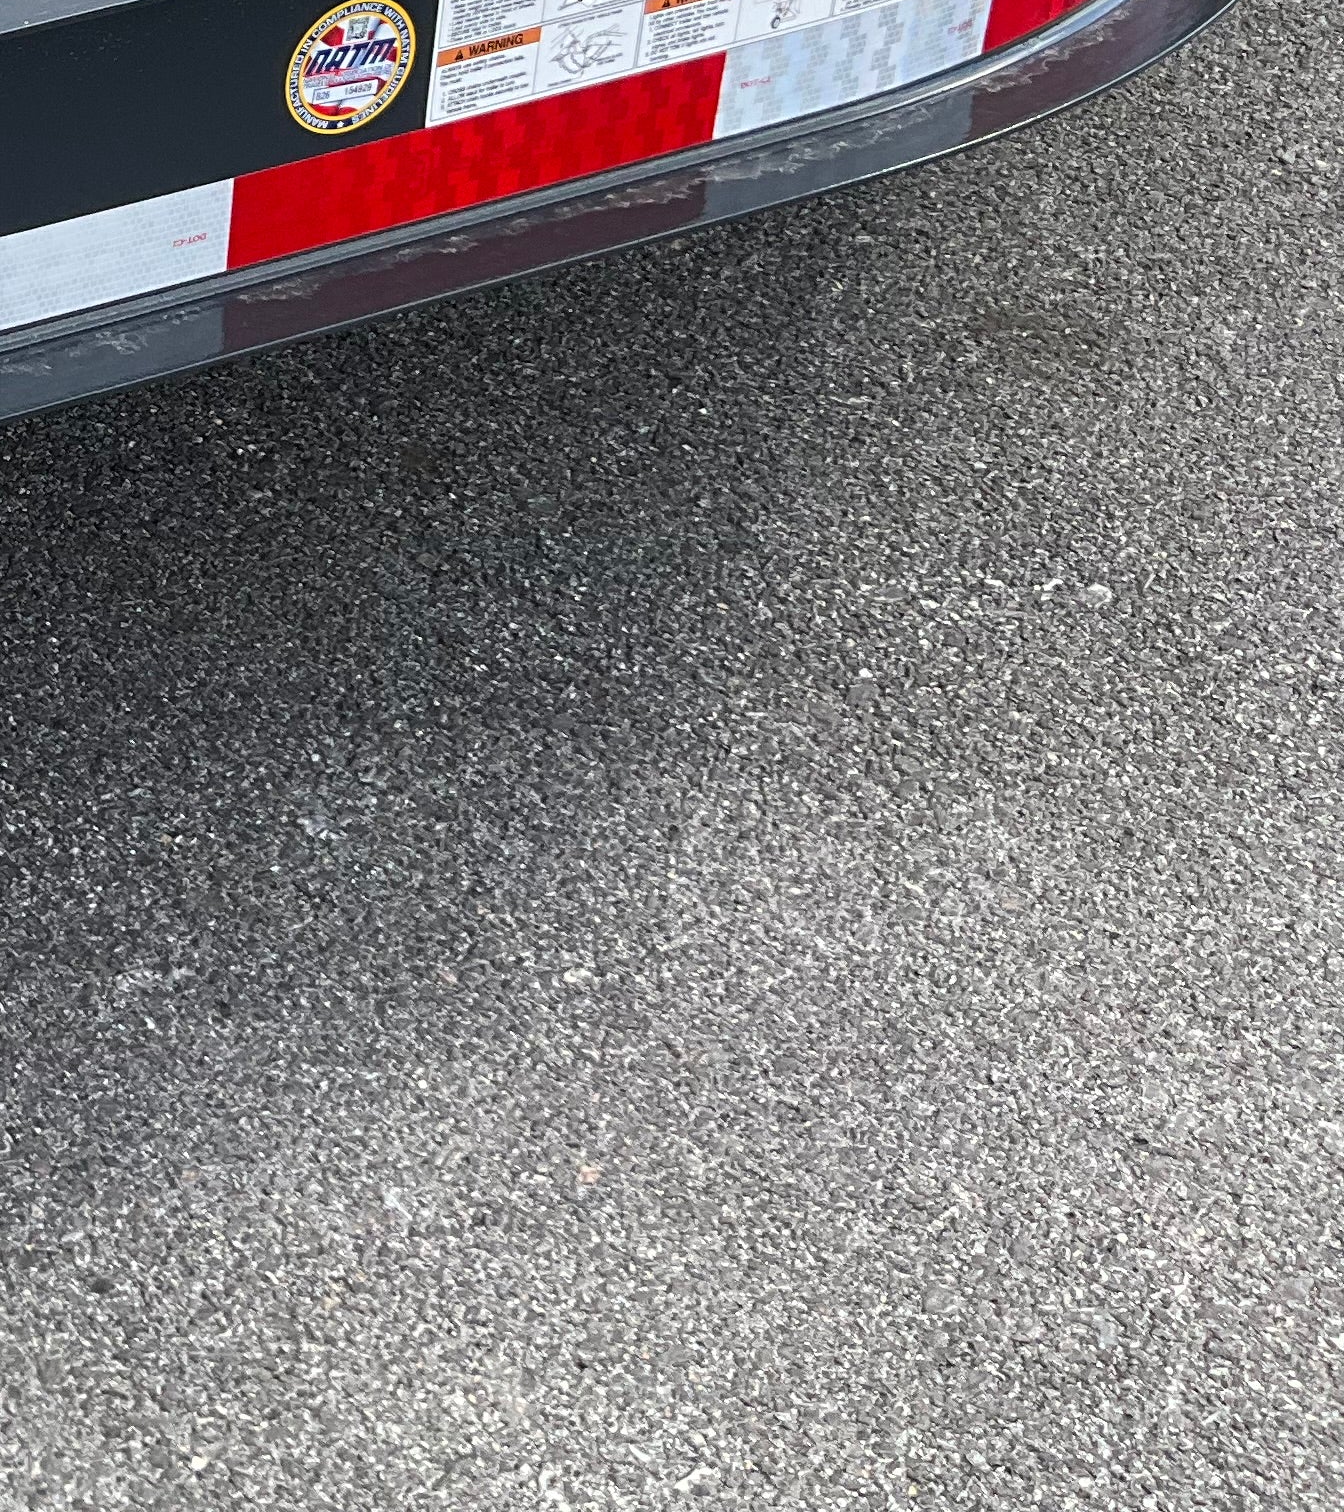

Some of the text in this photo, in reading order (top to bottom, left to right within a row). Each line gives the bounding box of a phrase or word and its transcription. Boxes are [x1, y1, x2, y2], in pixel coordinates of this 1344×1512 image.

[312, 2, 385, 39] COMPLIANCE
[384, 7, 406, 31] WITH
[304, 38, 398, 77] NATM
[469, 33, 524, 56] WARNING
